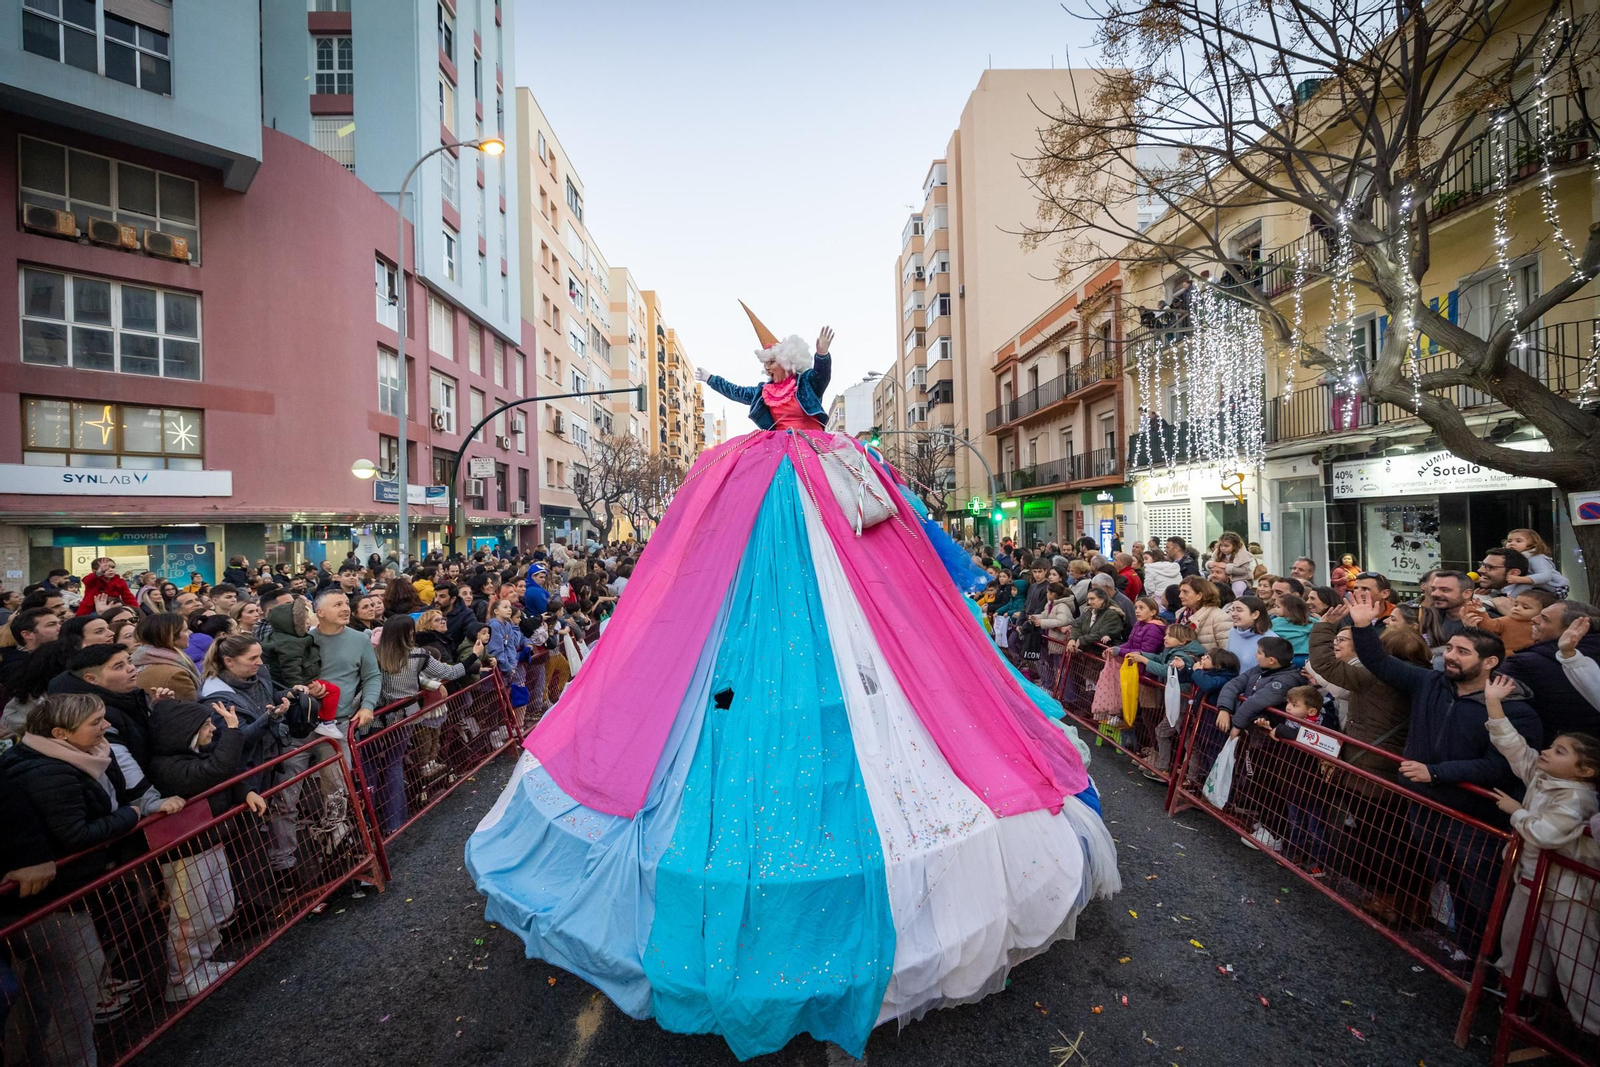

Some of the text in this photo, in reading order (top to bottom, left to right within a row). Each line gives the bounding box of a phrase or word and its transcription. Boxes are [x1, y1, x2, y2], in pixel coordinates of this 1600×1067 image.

[1334, 470, 1353, 480] 40%
[1433, 464, 1480, 477] Sotelo
[63, 473, 131, 485] SYNLAB
[1434, 478, 1448, 486] PVC
[1455, 477, 1483, 485] Aluminio
[1335, 485, 1354, 494] 15%
[123, 532, 168, 540] movistar
[1391, 557, 1421, 570] 15%
[1023, 651, 1040, 659] ICON
